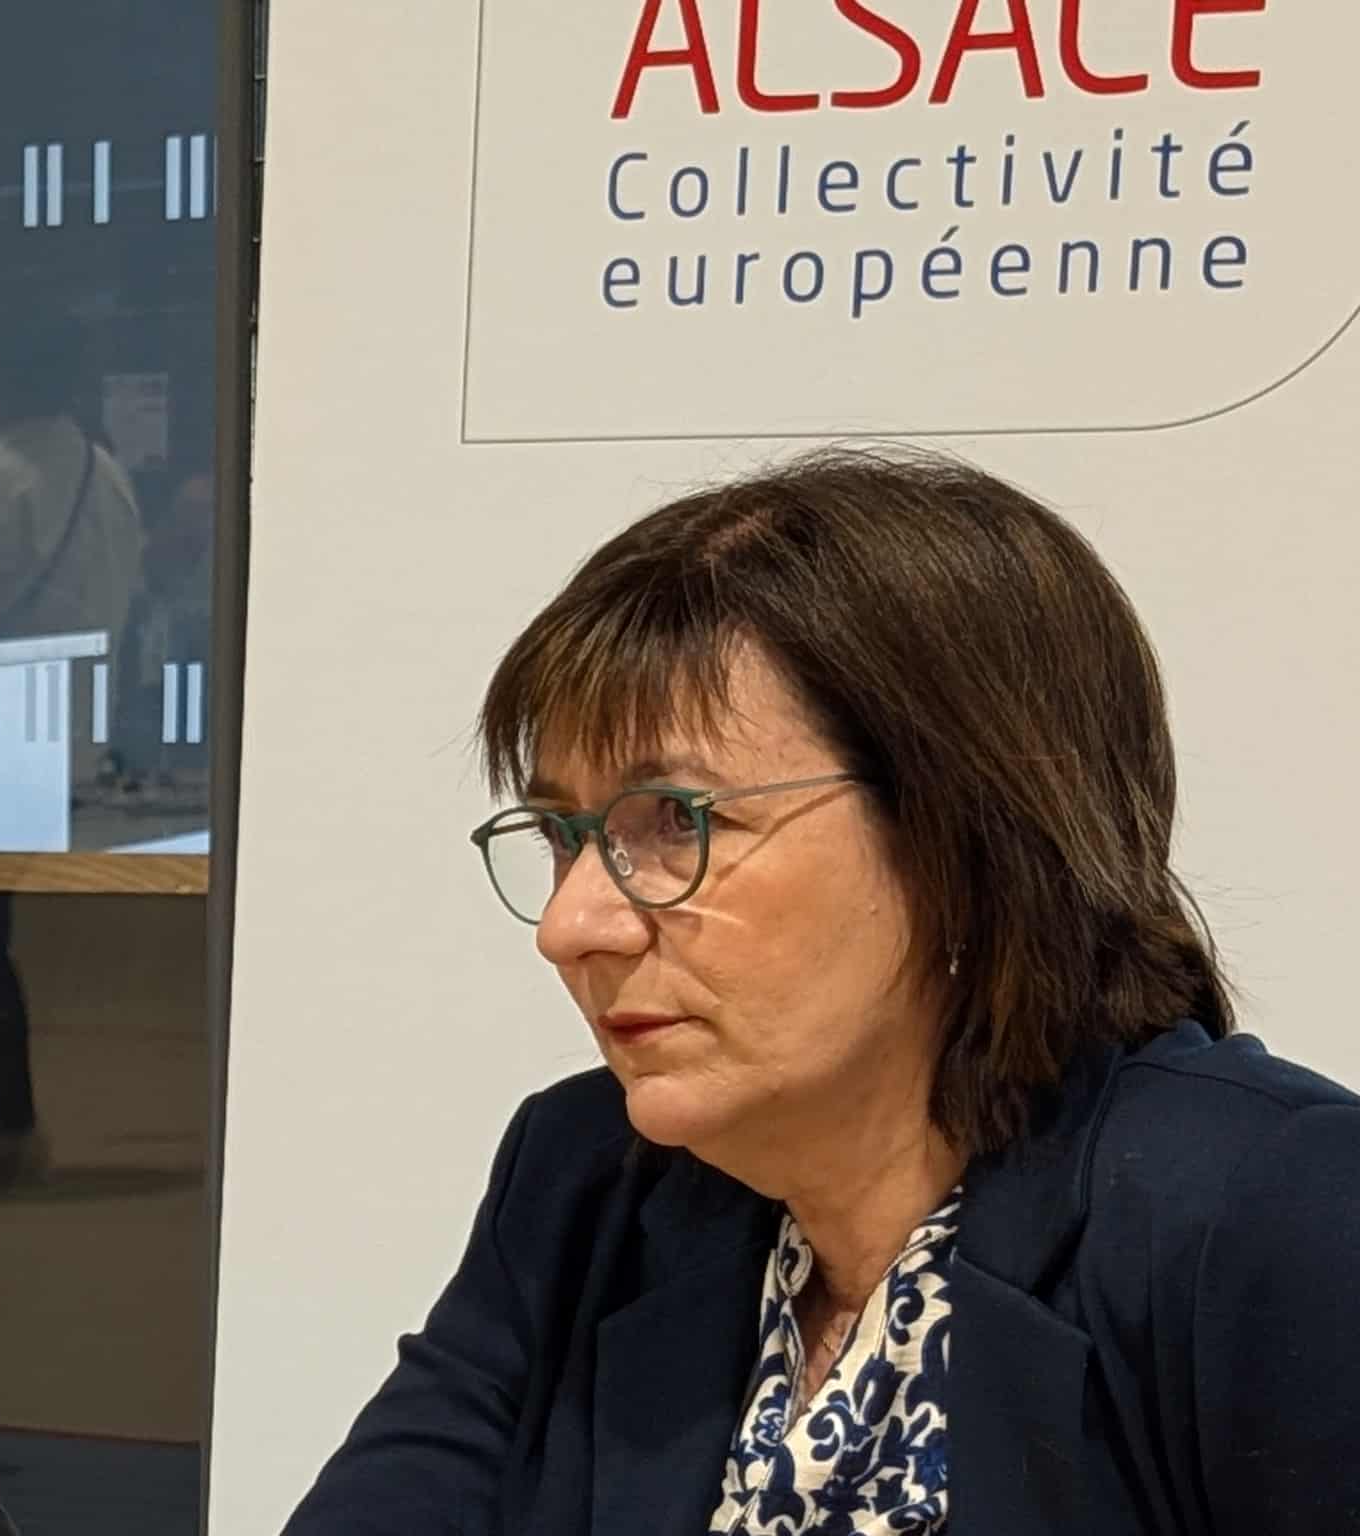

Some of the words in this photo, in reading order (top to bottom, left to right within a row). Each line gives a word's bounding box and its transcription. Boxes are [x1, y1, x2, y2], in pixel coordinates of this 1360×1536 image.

[610, 0, 1267, 119] ALSACE
[608, 120, 1255, 220] Collectivité
[601, 226, 1248, 319] européenne
